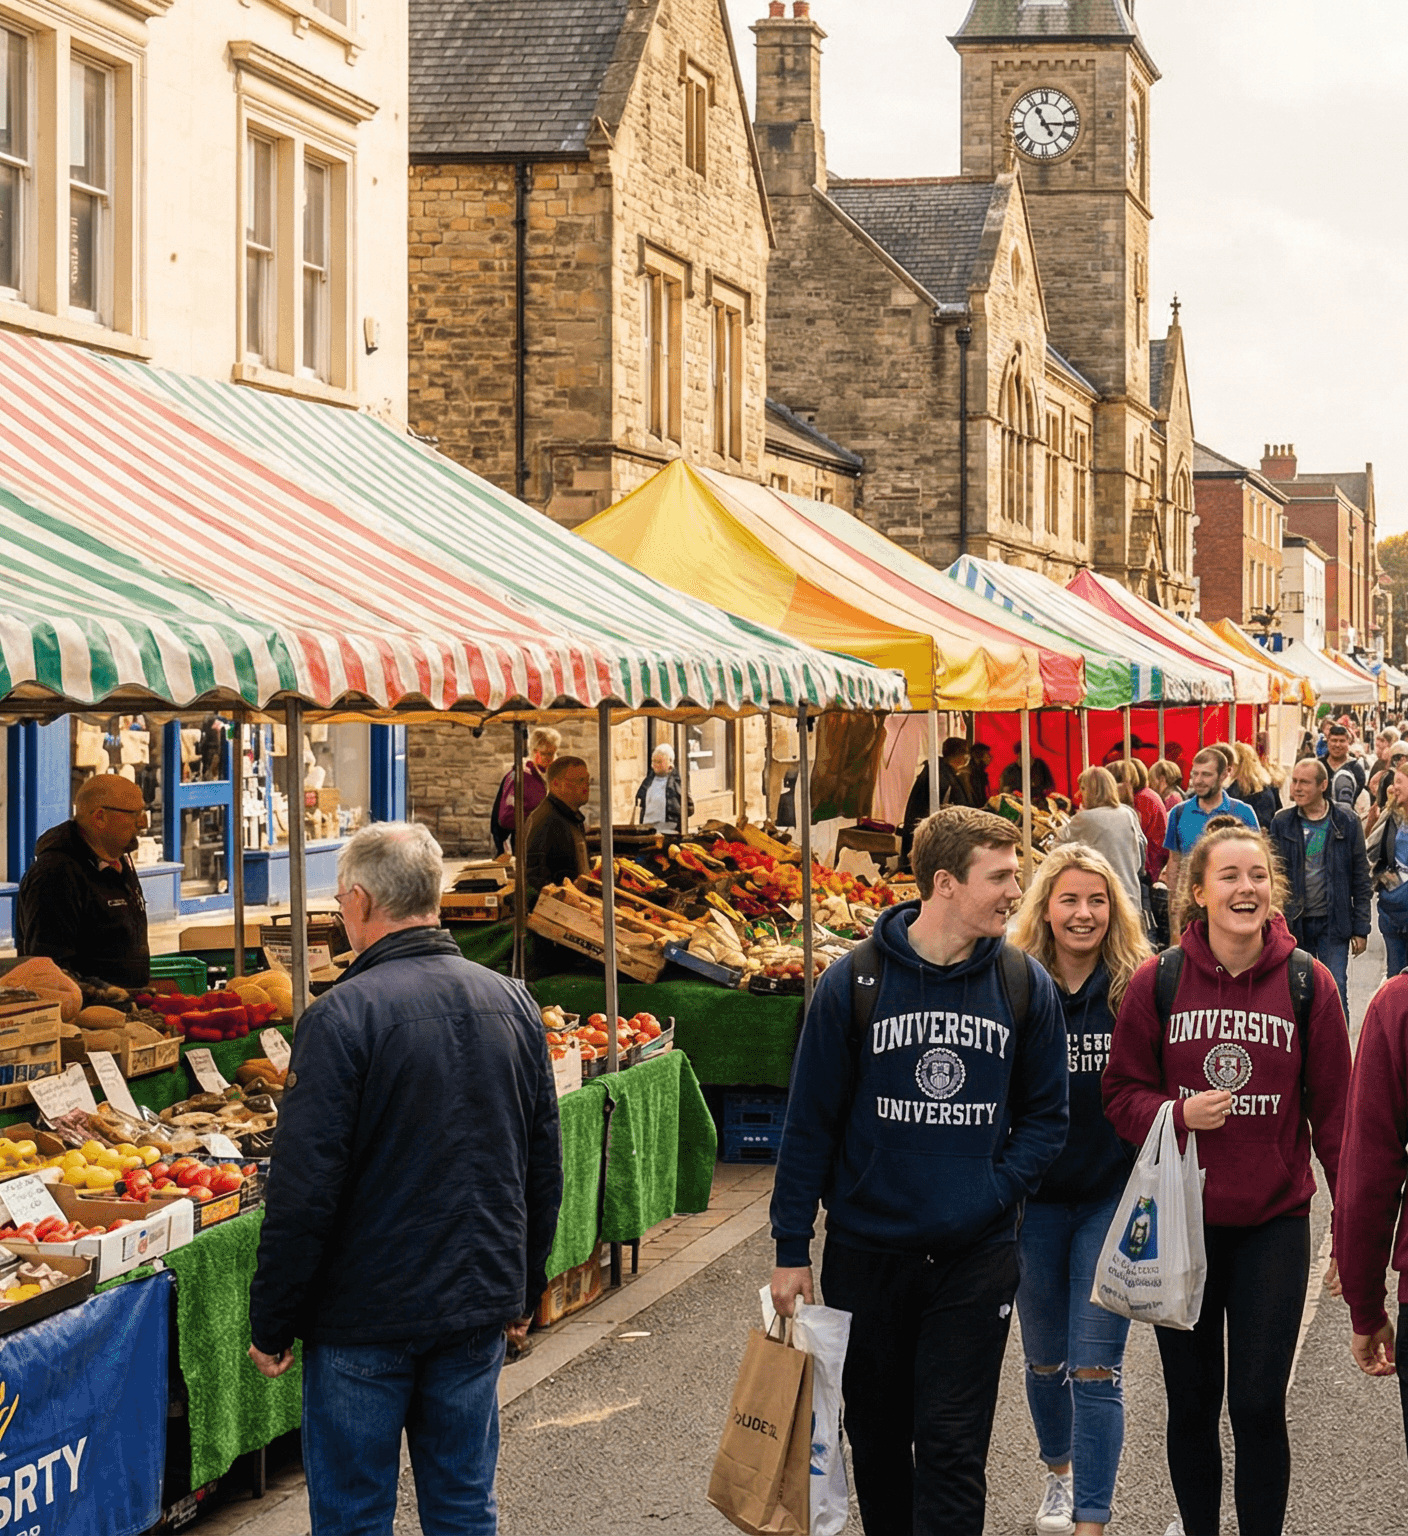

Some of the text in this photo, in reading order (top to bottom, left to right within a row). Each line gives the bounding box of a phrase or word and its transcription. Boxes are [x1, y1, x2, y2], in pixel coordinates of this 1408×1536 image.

[873, 1011, 1010, 1059] UNIVERSITY
[1169, 1009, 1294, 1053] UNIVERSITY
[876, 1096, 997, 1126] UNIVERSITY
[1178, 1085, 1281, 1116] URSITY
